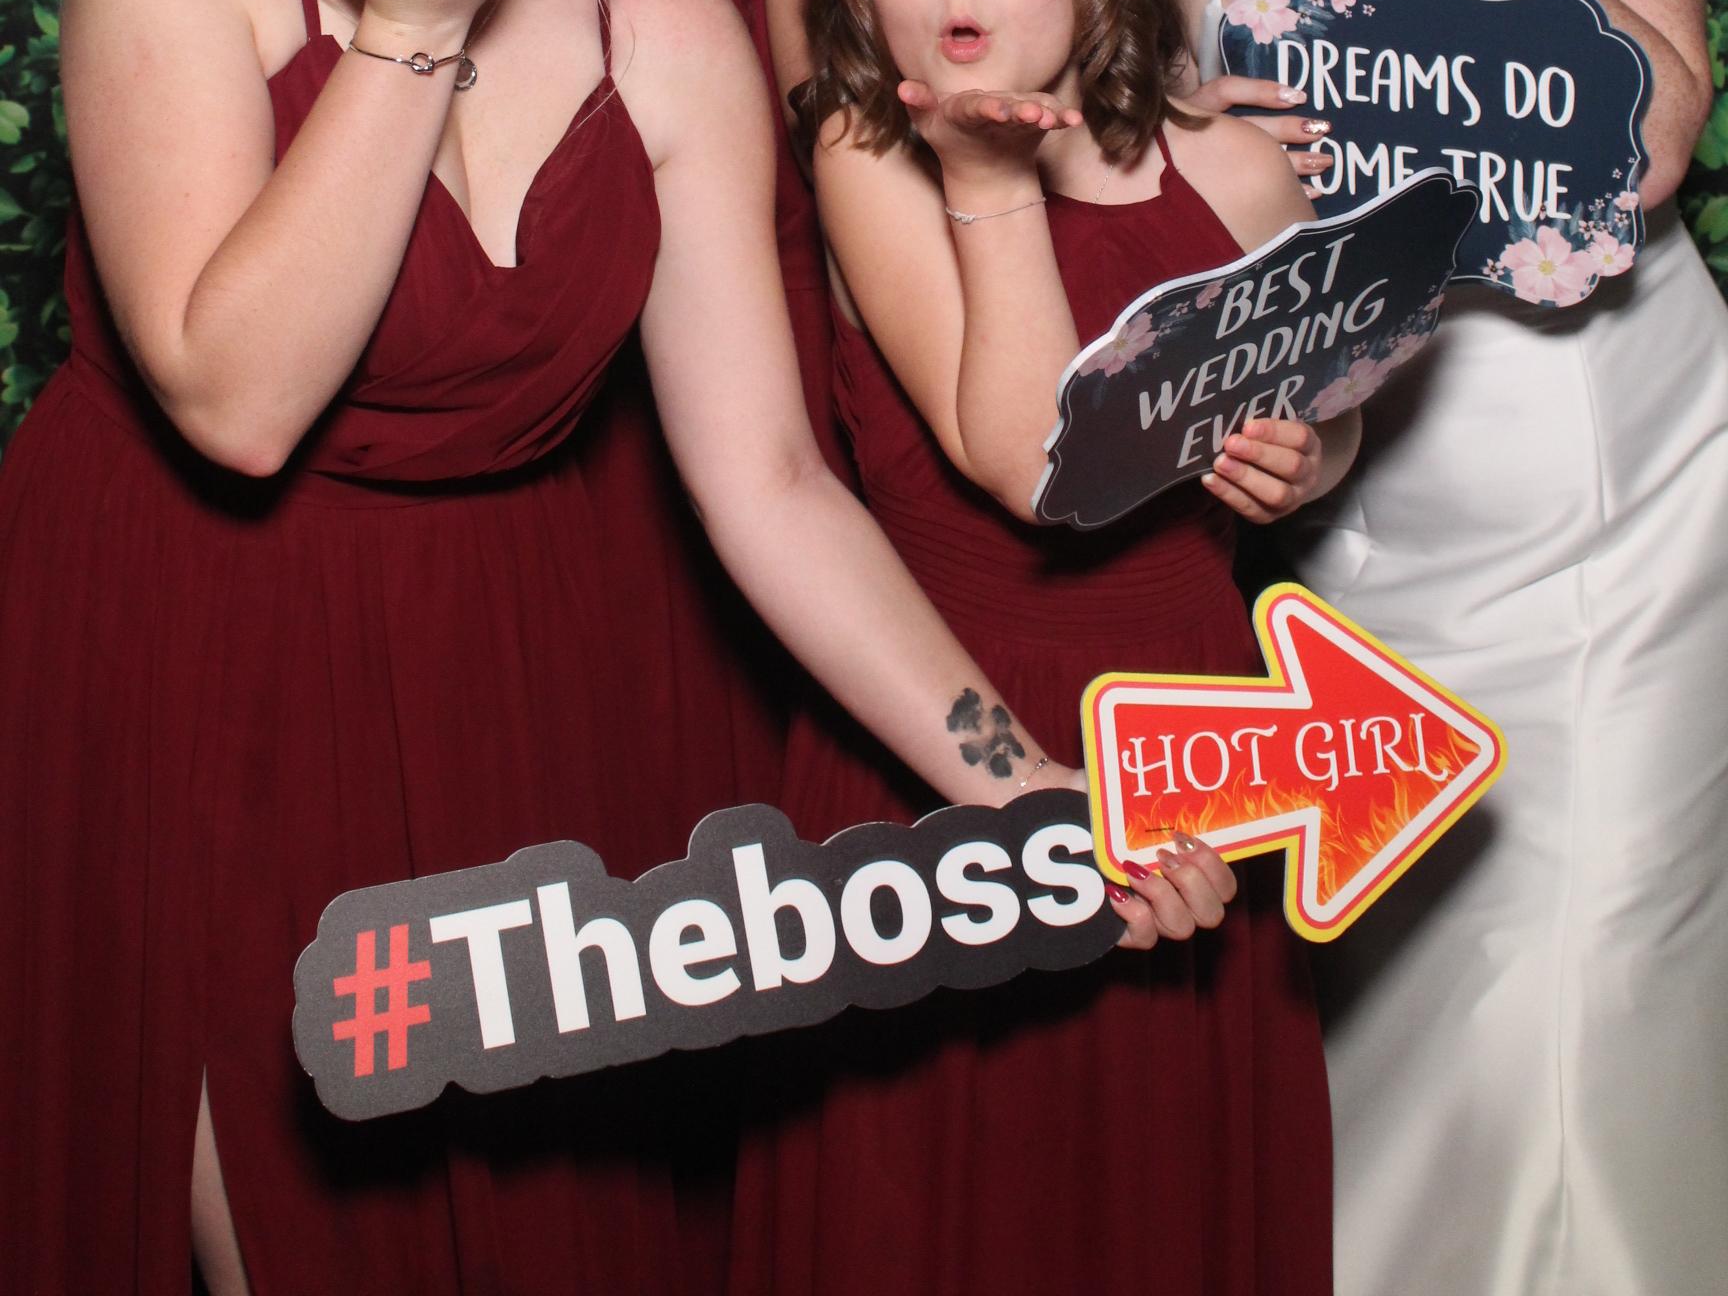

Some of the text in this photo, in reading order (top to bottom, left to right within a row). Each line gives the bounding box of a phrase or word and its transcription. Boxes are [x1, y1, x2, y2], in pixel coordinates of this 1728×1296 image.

[1277, 39, 1576, 127] DREAMS DO
[1281, 136, 1573, 223] OME TRUE
[1216, 233, 1355, 340] BEST
[1138, 279, 1390, 431] WEDDING
[1176, 375, 1305, 469] EVER
[1121, 712, 1454, 797] HOT GIRL
[333, 823, 1106, 1078] #Theboss
